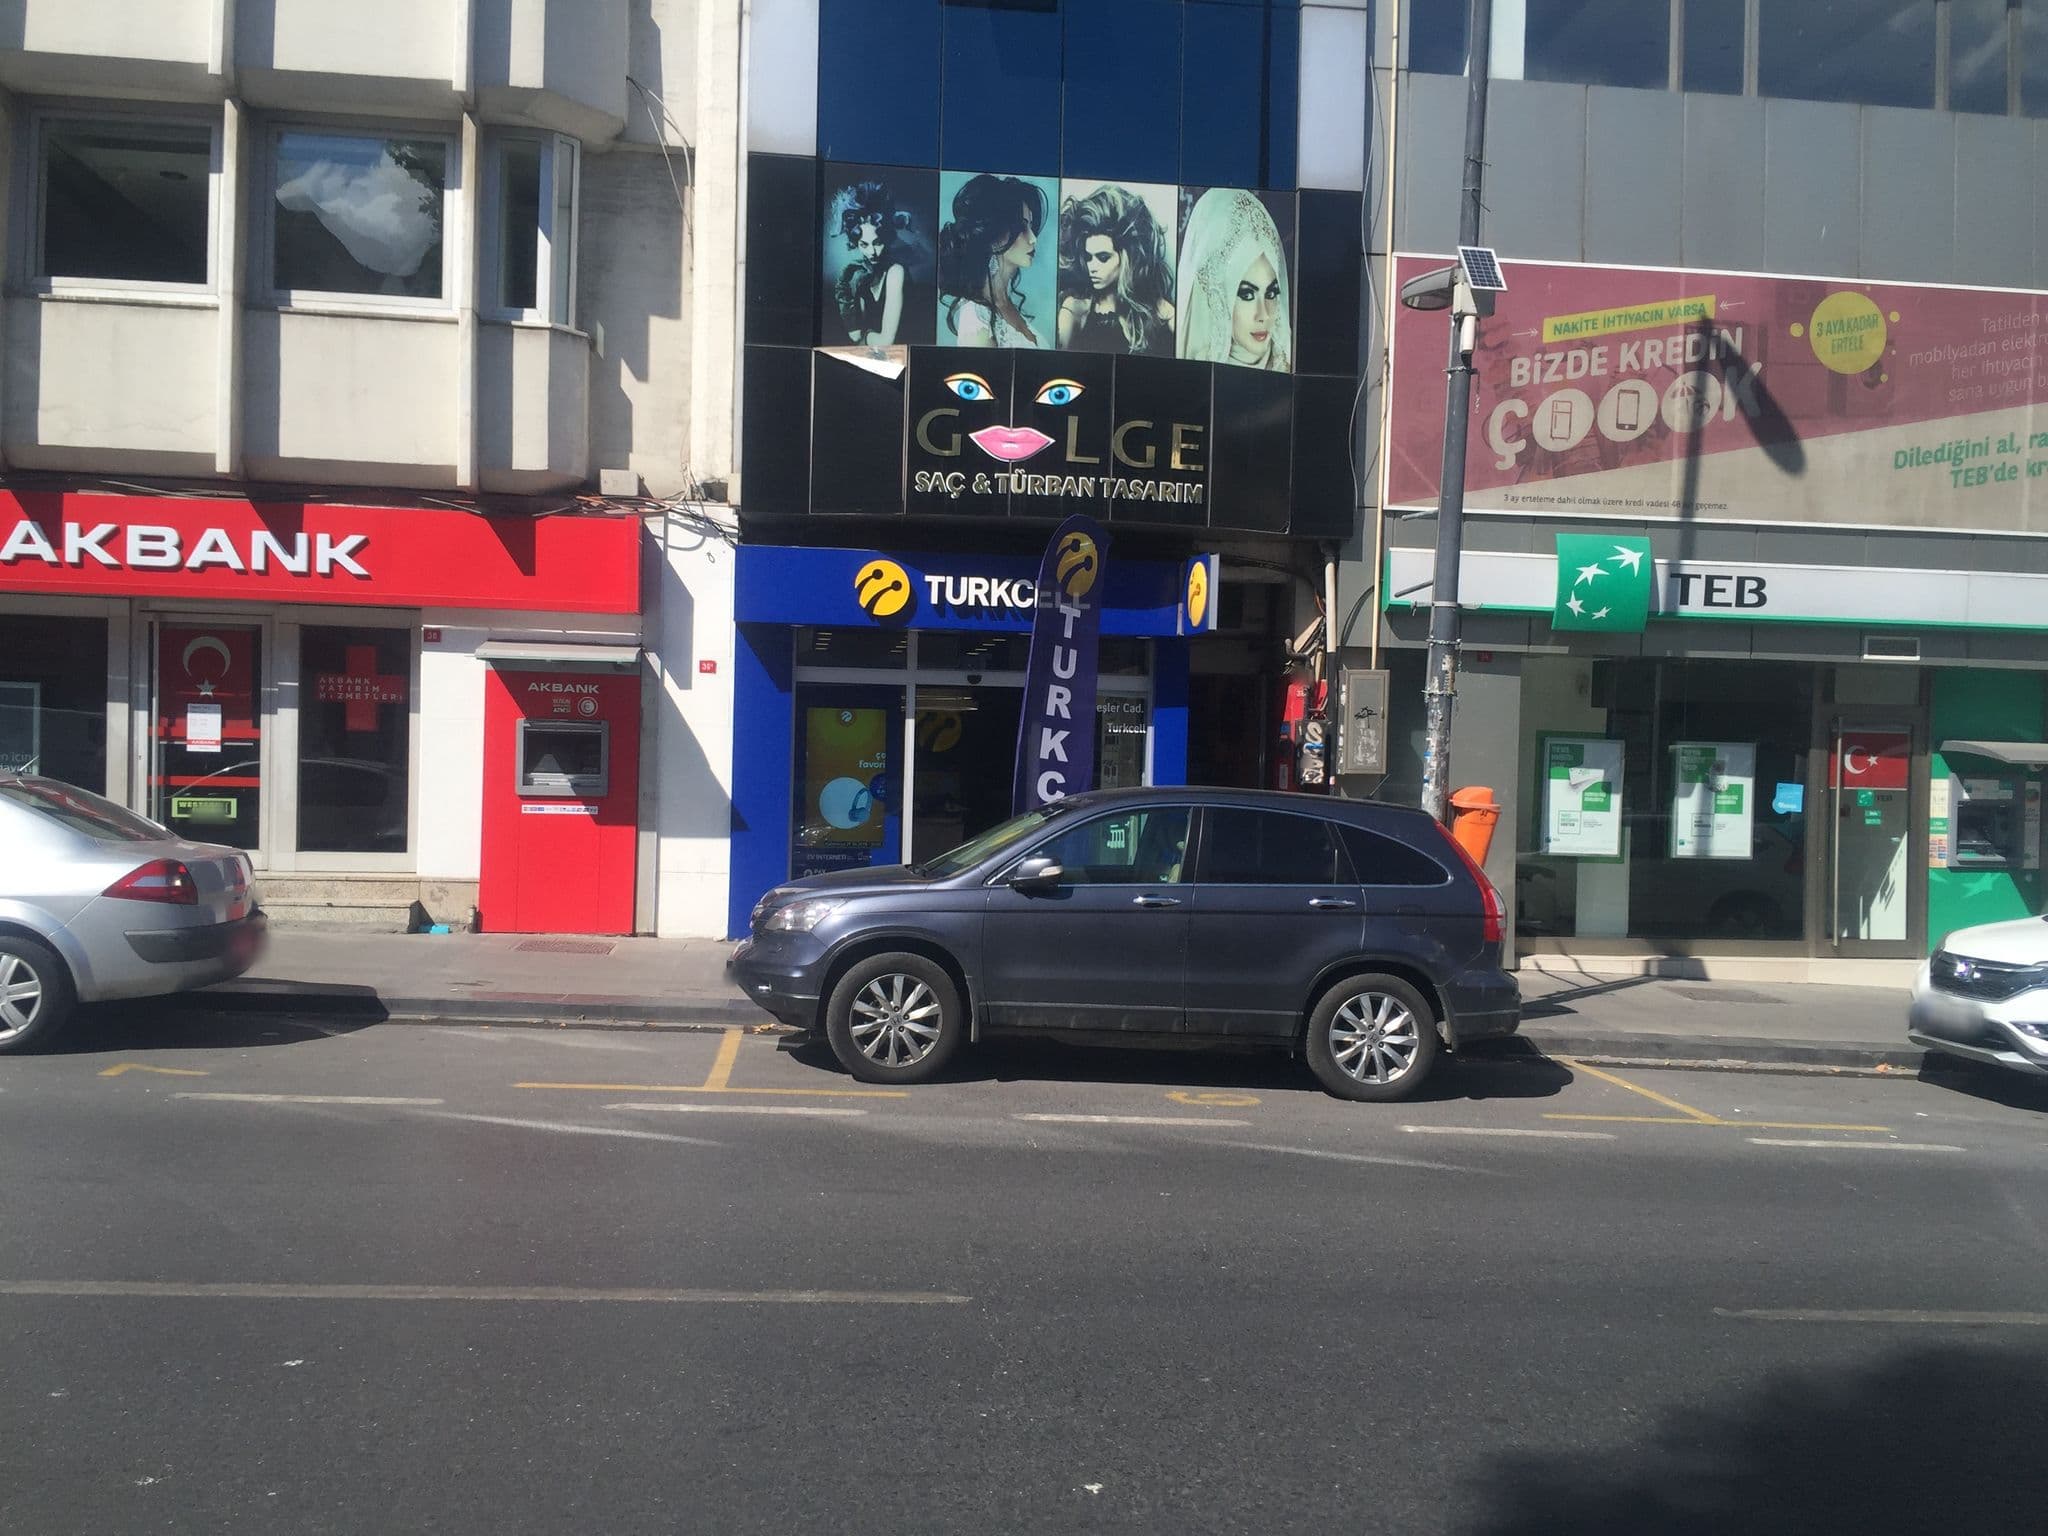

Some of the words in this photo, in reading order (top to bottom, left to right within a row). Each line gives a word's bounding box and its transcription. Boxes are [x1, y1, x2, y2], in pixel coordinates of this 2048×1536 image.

[1553, 318, 1599, 336] NAKİTE
[1603, 310, 1664, 328] İHTİYACIN
[1669, 302, 1707, 319] VARSA
[1816, 321, 1824, 338] 3
[1894, 435, 1990, 470] Dilediğini
[1996, 432, 2021, 454] al,
[915, 470, 966, 499] SAÇ
[972, 474, 991, 495] &
[1100, 477, 1203, 504] TASARIM
[1950, 462, 2019, 489] TEB'de
[0, 519, 373, 579] AKBANK
[1670, 573, 1768, 608] TEB
[319, 676, 370, 685] AKBANK
[527, 682, 600, 694] AKBANK
[1123, 703, 1144, 713] Cad.
[1107, 722, 1147, 734] Turkcell
